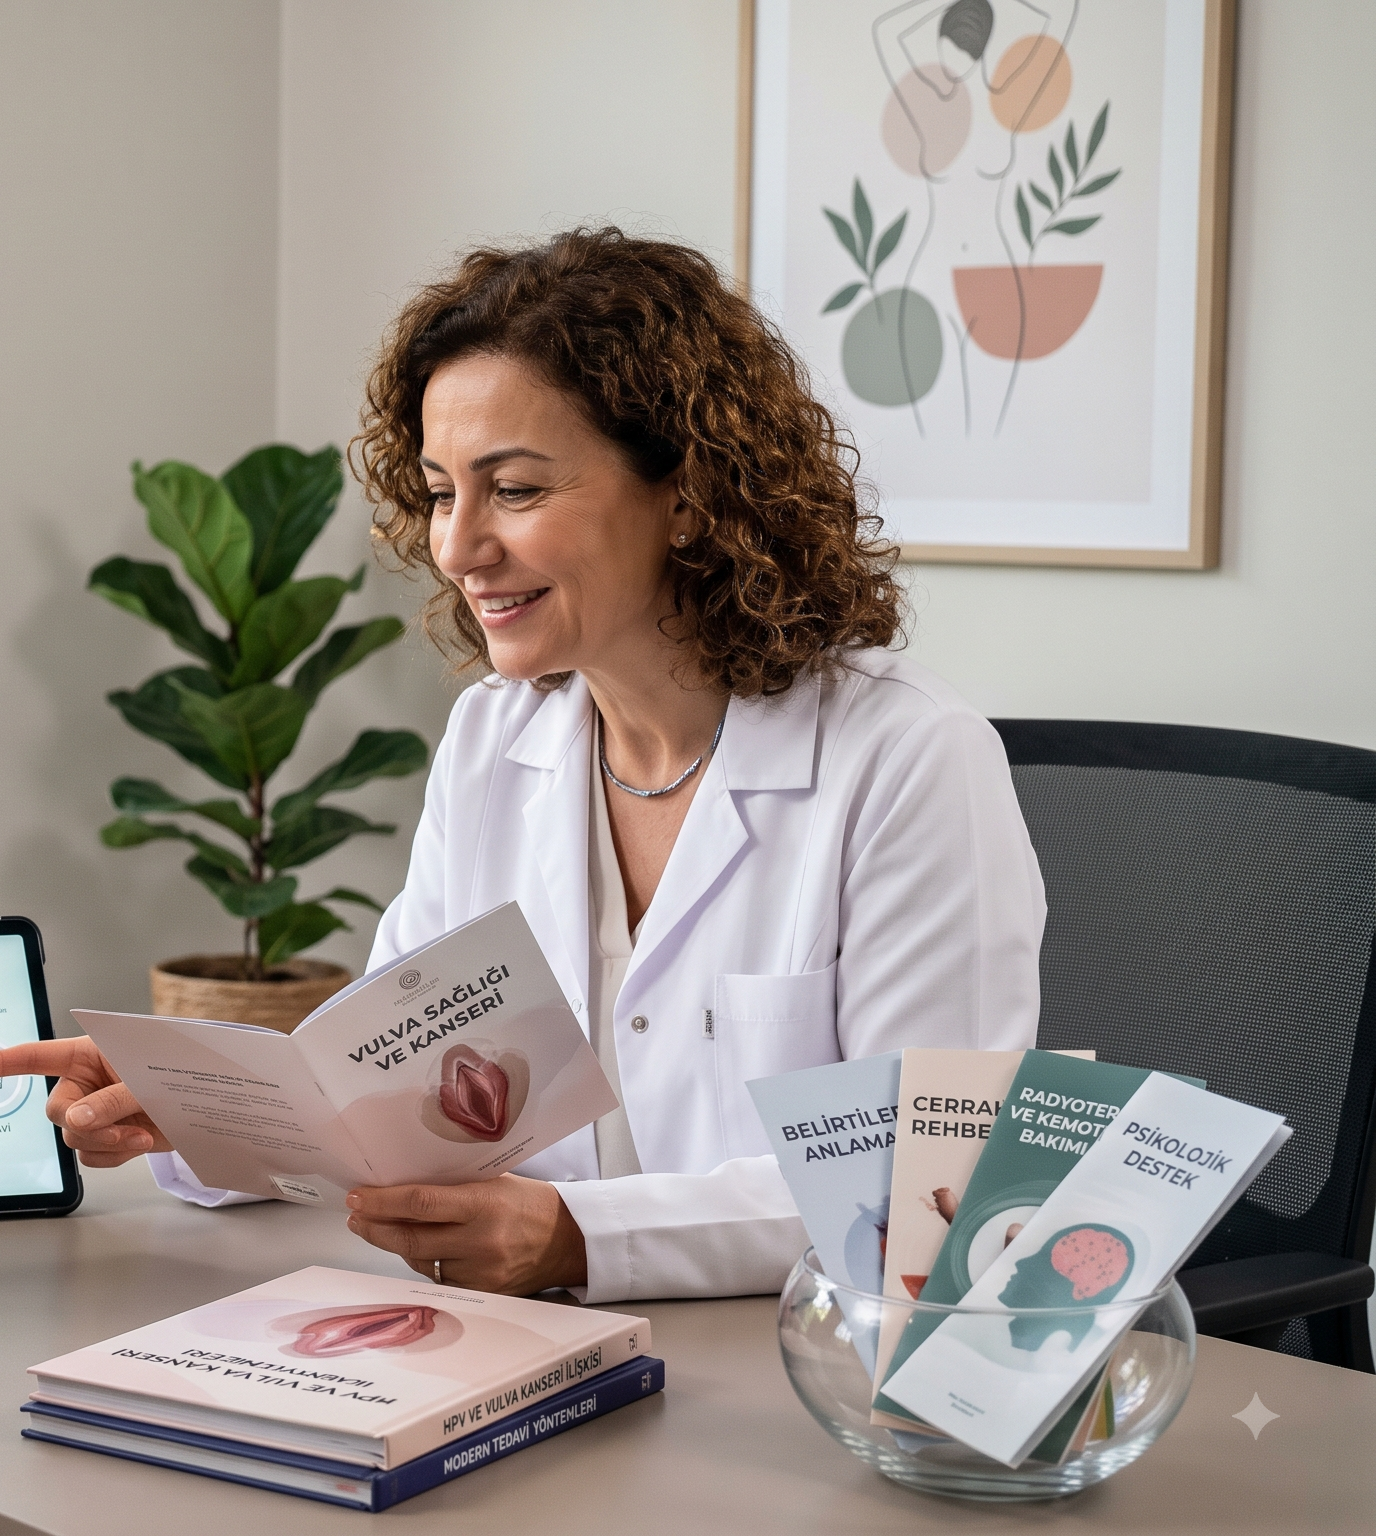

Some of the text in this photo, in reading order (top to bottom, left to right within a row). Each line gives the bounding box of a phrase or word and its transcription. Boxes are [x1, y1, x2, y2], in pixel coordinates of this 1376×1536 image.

[348, 1017, 422, 1063] VULVA
[424, 964, 510, 1021] SAĞLIĞI
[374, 1048, 407, 1071] VE
[409, 988, 505, 1054] KANSERİ
[1010, 1104, 1036, 1123] VE
[1019, 1087, 1120, 1120] RADYOTER
[912, 1119, 991, 1139] REHBE
[1019, 1128, 1089, 1155] BAKIMI
[1123, 1121, 1233, 1174] PSİKOLOJİK
[1123, 1150, 1201, 1190] DESTEK
[301, 1383, 337, 1395] VE
[339, 1391, 398, 1405] HPV
[443, 1411, 466, 1435] HPV
[468, 1404, 482, 1423] VE
[485, 1388, 519, 1415] VULVA
[521, 1363, 564, 1400] KANSERİ
[443, 1394, 597, 1475] MODERN TEDAVİ YÖNTEMLERİ
